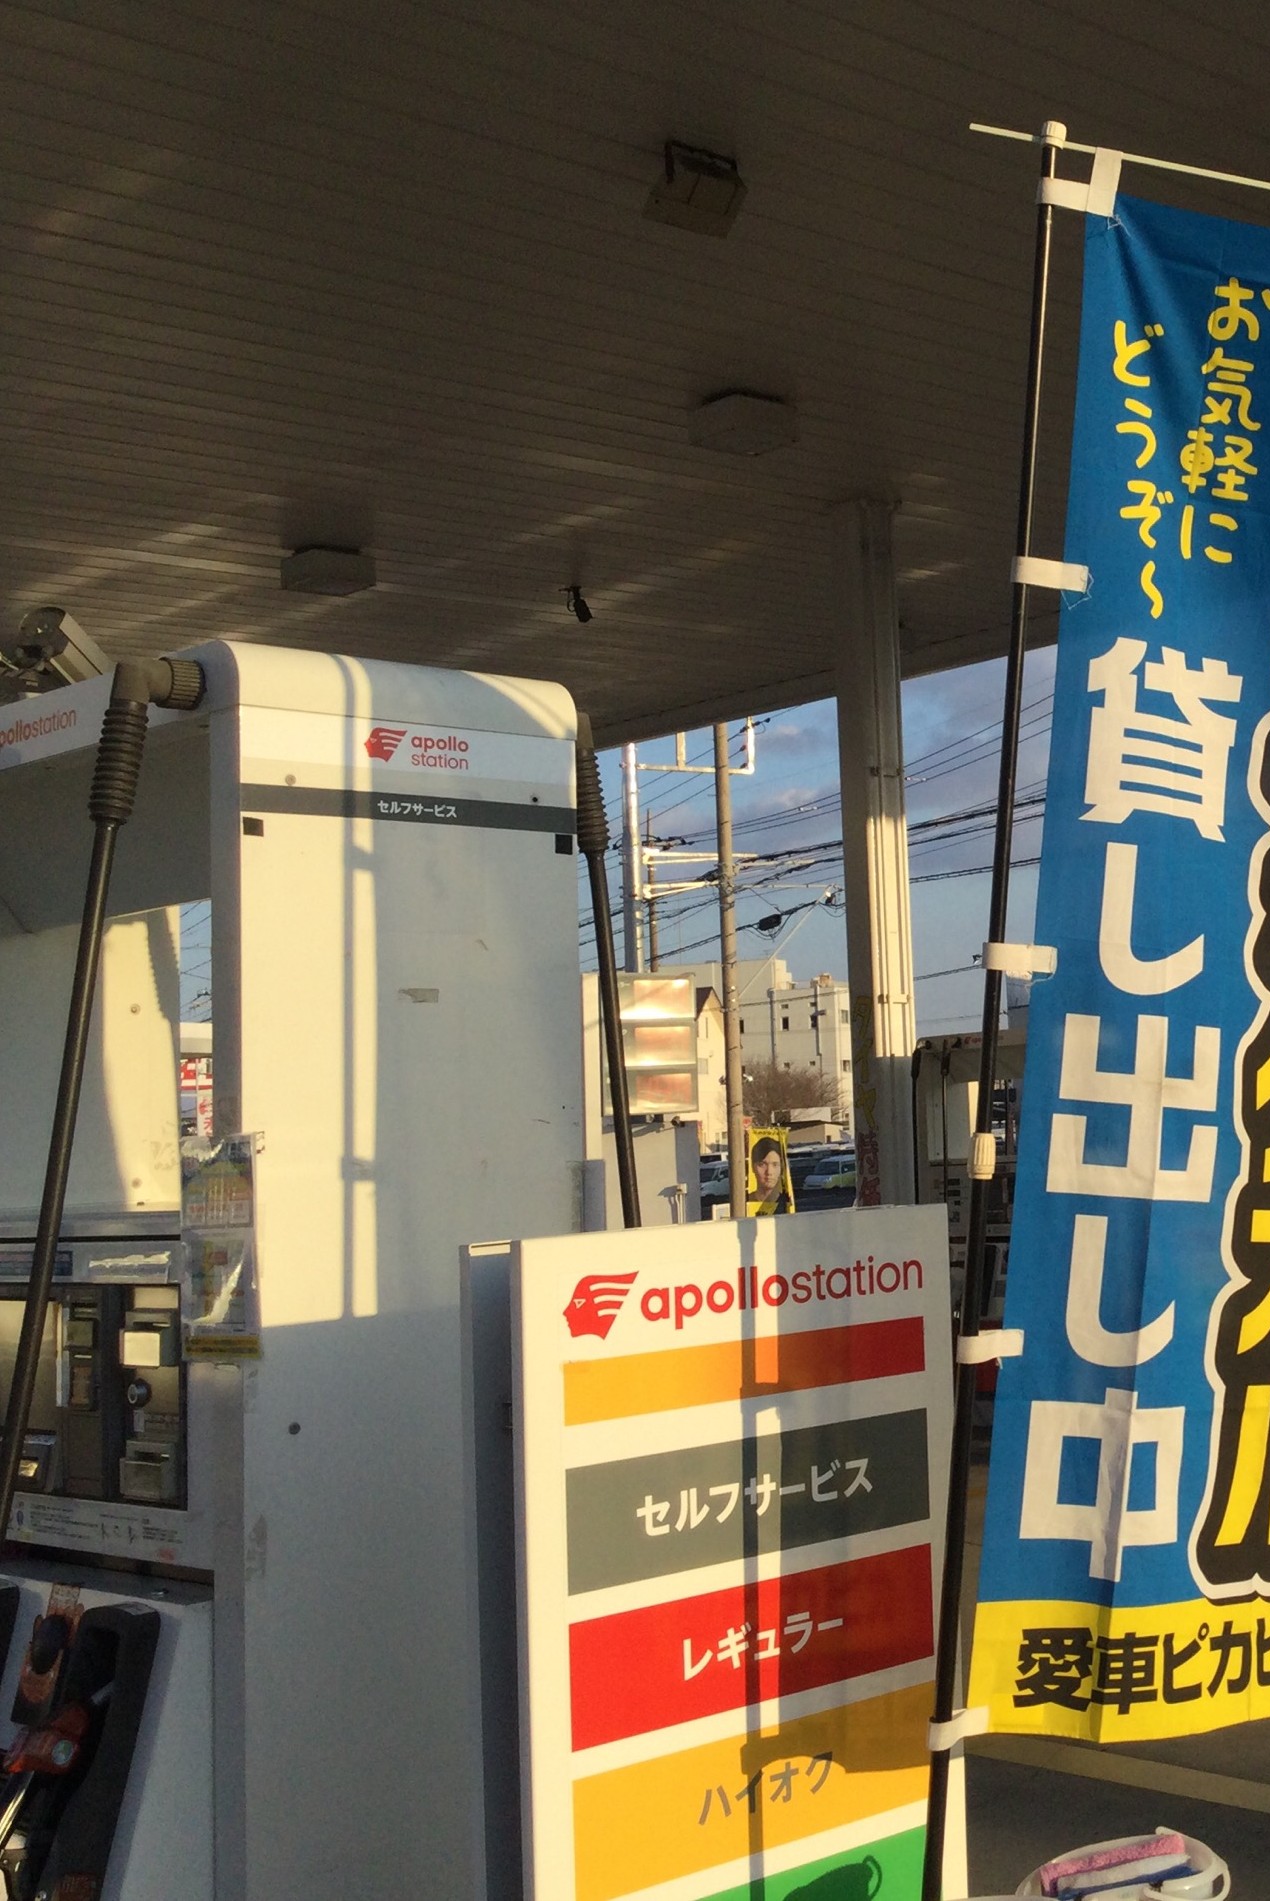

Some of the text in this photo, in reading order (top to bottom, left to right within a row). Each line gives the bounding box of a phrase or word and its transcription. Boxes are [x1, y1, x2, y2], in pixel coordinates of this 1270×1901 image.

[410, 735, 469, 753] apollo
[410, 752, 469, 770] station
[377, 800, 457, 818] セルフサービス
[1018, 635, 1243, 1583] 貸し出し中
[641, 1256, 923, 1330] apollostation
[637, 1458, 874, 1537] セルフサービス
[681, 1612, 844, 1681] レギュラー
[698, 1751, 834, 1826] ハイオク
